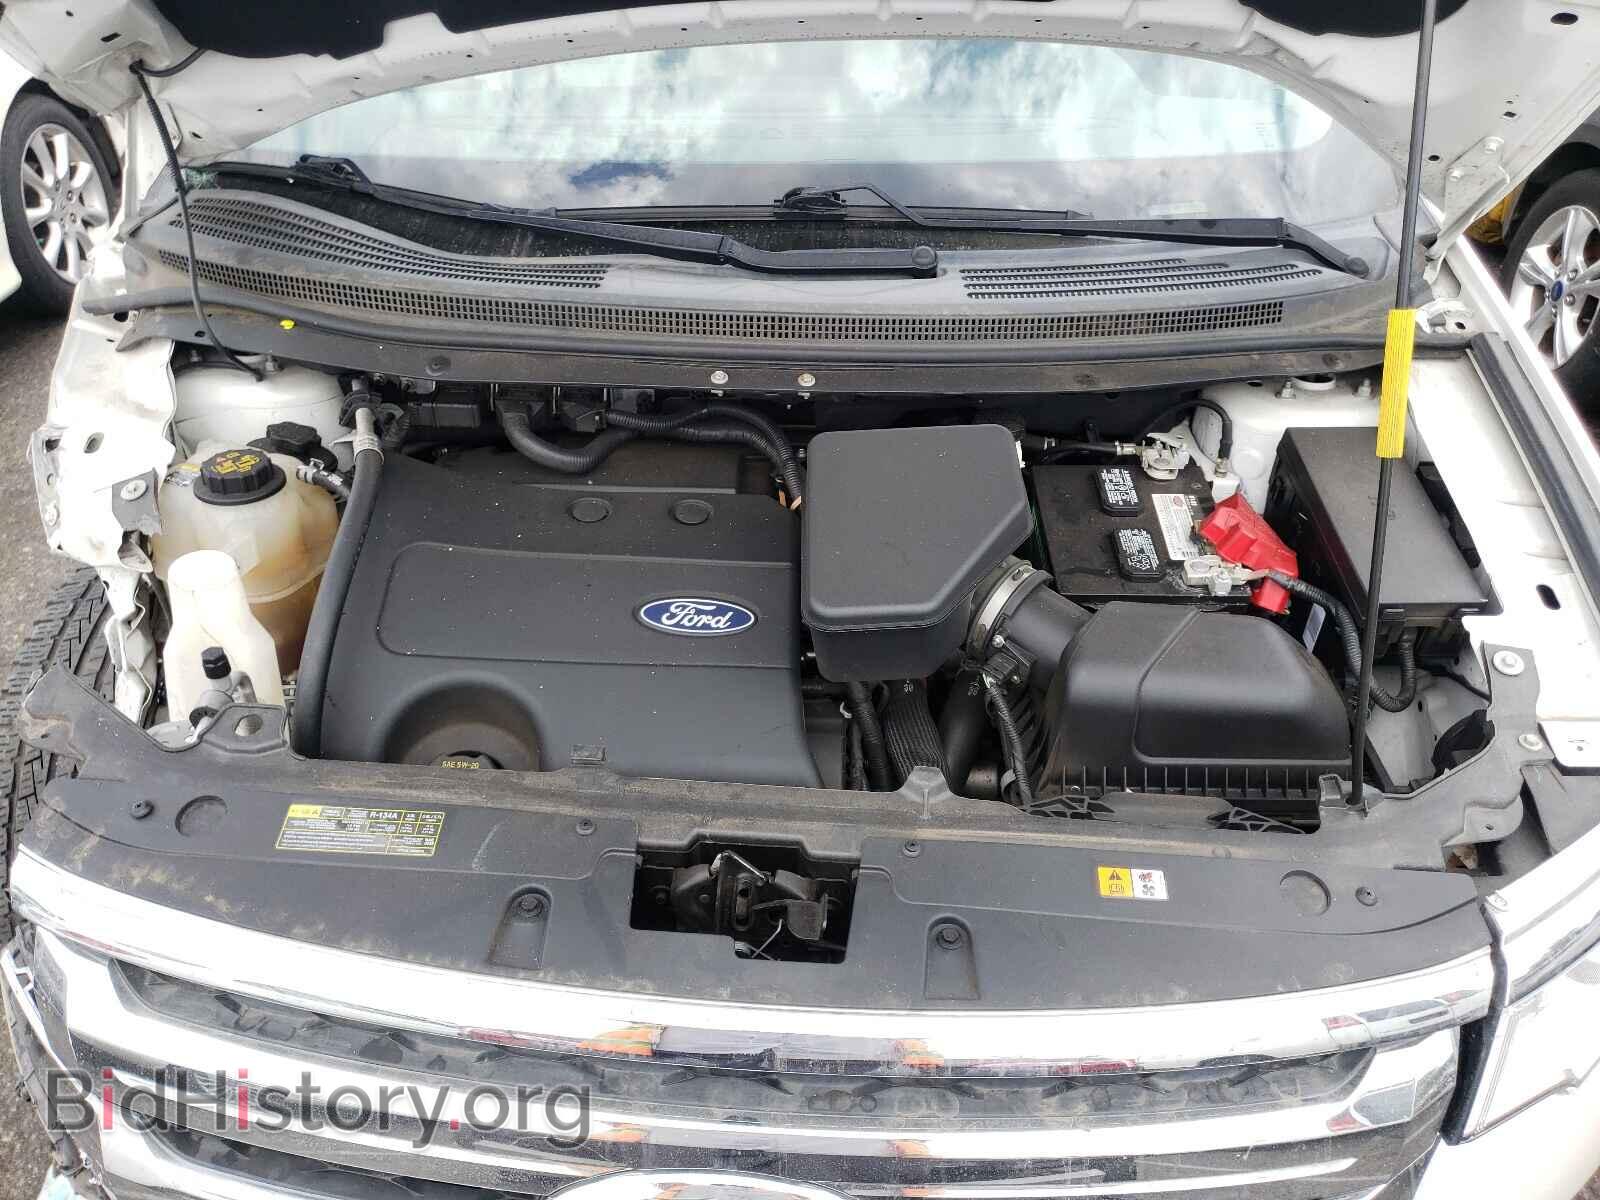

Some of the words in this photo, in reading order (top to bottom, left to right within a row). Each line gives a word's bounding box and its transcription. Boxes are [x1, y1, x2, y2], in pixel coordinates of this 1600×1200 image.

[660, 601, 734, 629] Ford
[441, 760, 456, 769] SAE
[457, 761, 480, 769] 5W-20
[369, 811, 398, 820] R-134A
